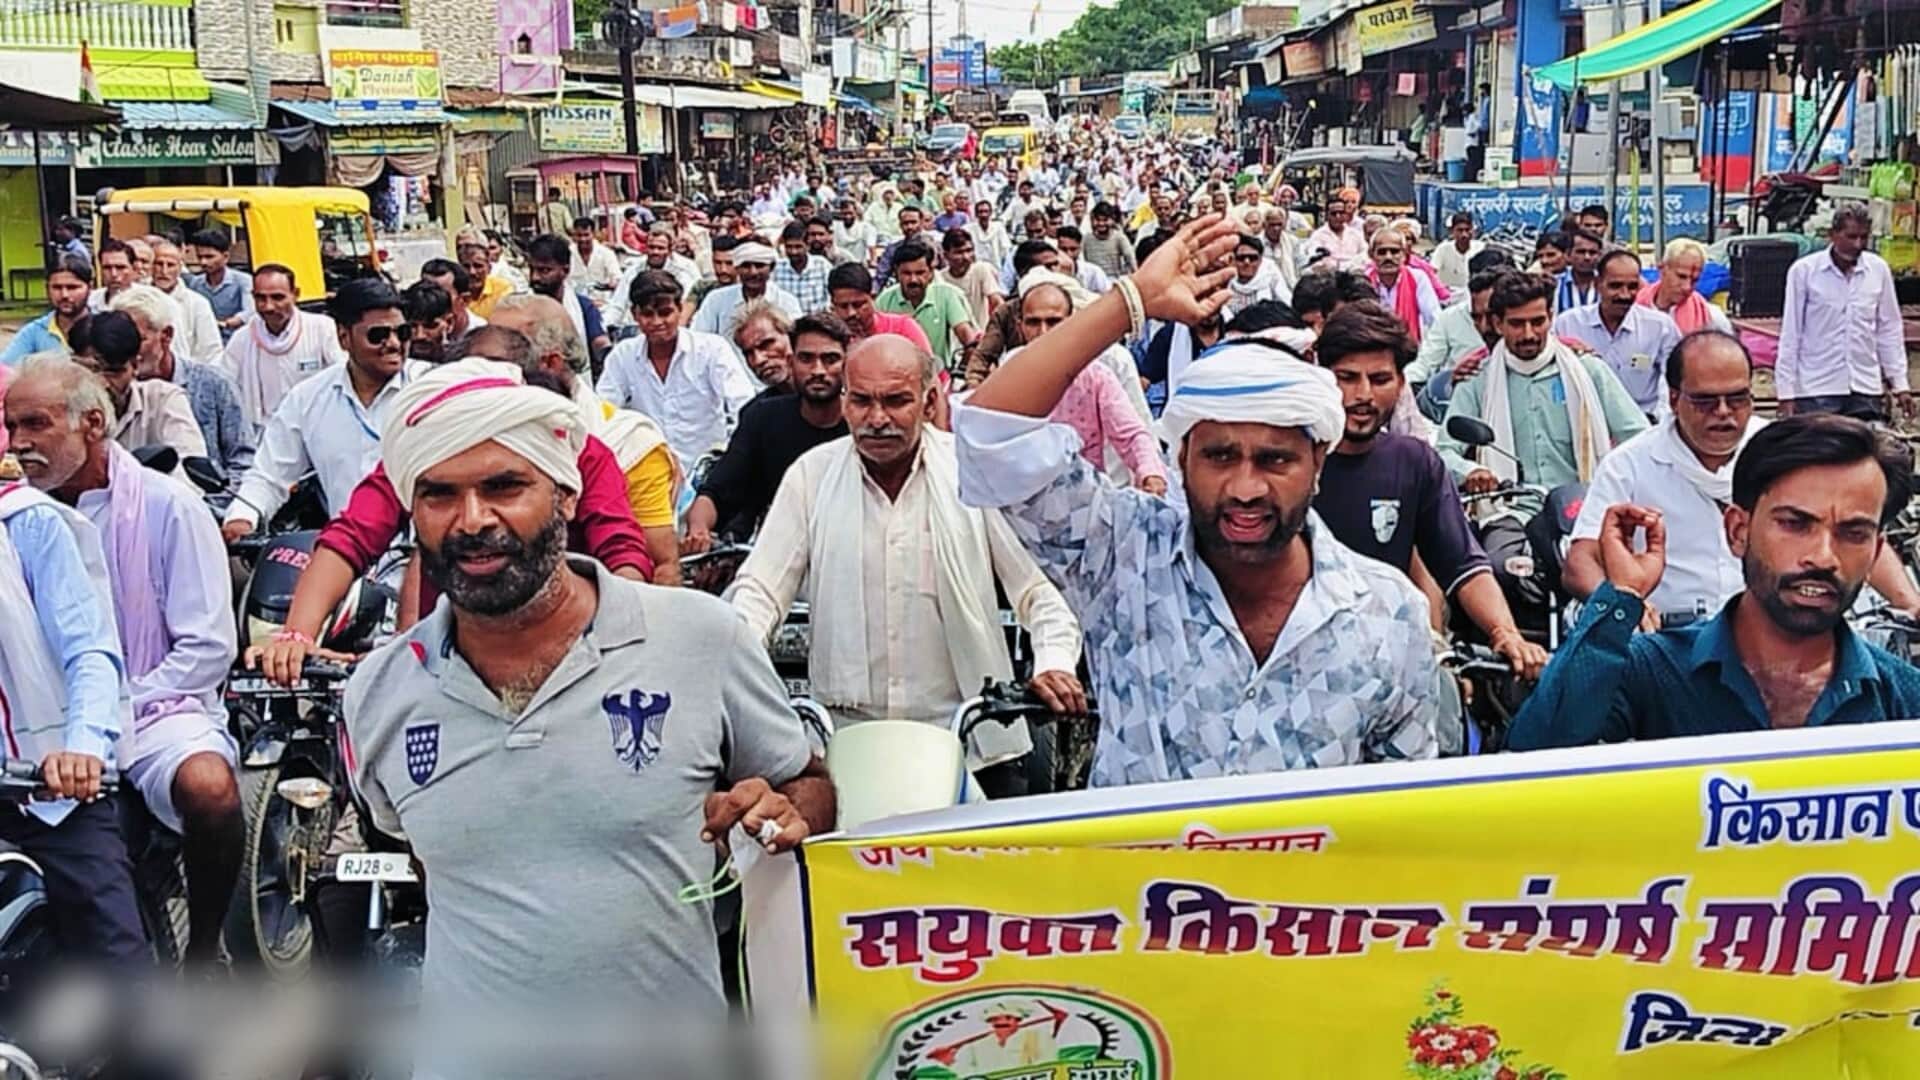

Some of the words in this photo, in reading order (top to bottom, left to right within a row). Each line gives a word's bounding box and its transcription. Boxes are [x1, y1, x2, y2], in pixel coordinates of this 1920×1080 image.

[359, 68, 415, 82] Danish
[542, 107, 611, 120] NISSAN
[103, 134, 160, 158] Classic
[211, 135, 255, 157] Salon
[1705, 777, 1893, 847] किसान
[343, 859, 381, 875] RJ28
[1144, 880, 1447, 957] किसान
[1461, 877, 1687, 964] संघर्ष
[1623, 992, 1788, 1051] जिला
